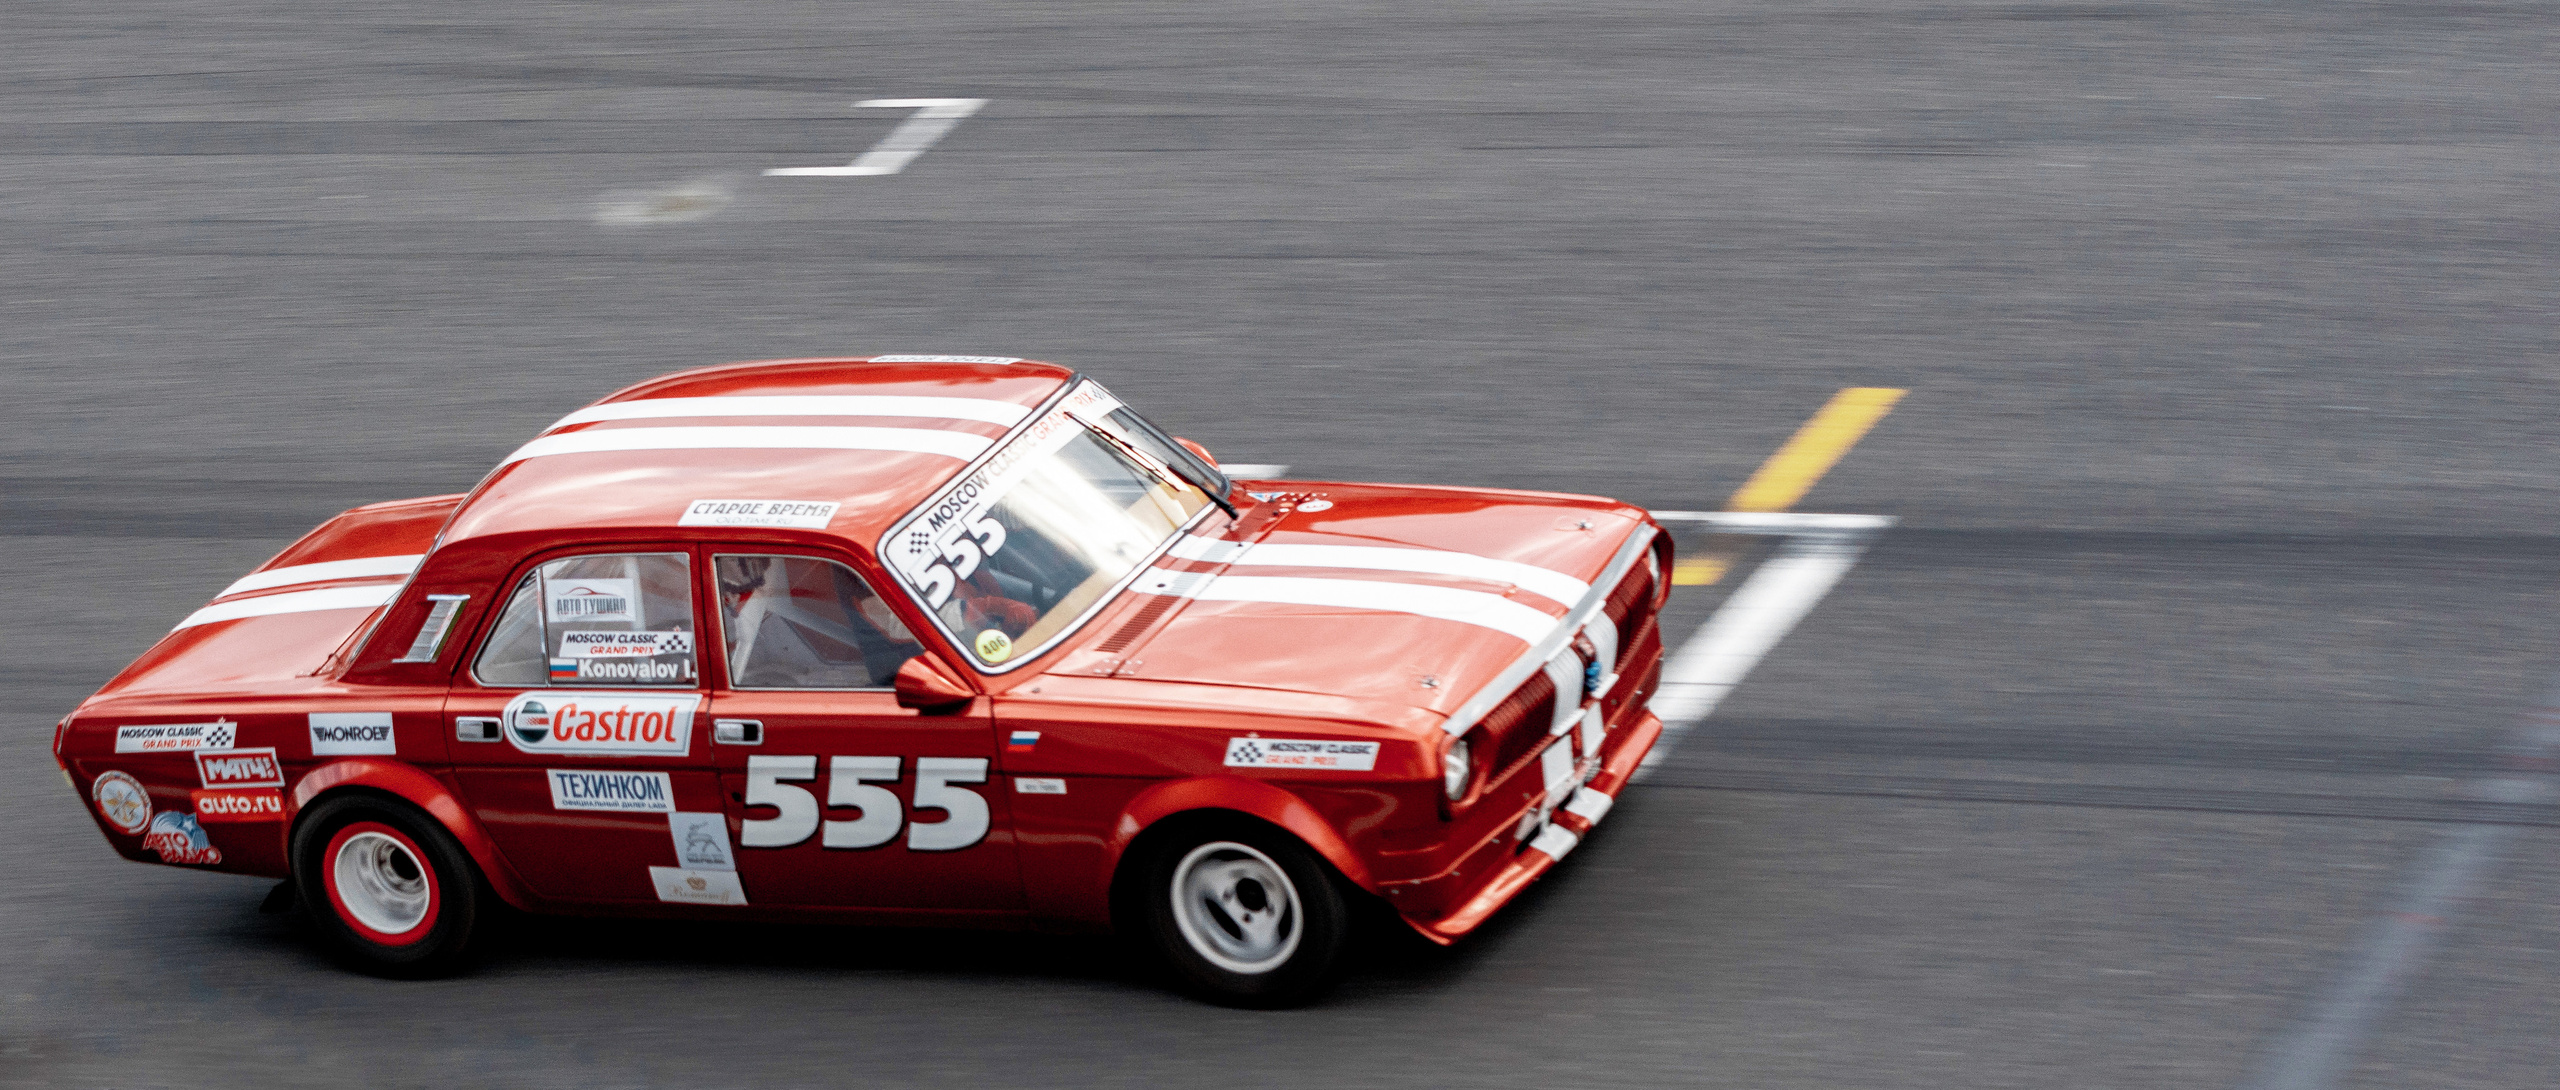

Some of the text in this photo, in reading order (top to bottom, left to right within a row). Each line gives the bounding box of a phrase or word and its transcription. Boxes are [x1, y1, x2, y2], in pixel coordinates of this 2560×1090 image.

[928, 470, 990, 532] MOSCOW
[988, 434, 1036, 476] CLASSIC
[693, 503, 833, 517] СТАРОЕ ВРЕМЯ
[907, 503, 1006, 611] 555
[557, 598, 626, 614] АВТО ТУШИНО
[566, 634, 658, 643] MOSCOW CLASSIC
[982, 635, 1007, 655] 406
[590, 646, 654, 655] GRAND PRIX
[580, 659, 678, 678] Konovalov
[553, 703, 677, 743] Castrol
[121, 727, 204, 739] MOSCOW CLASSIC
[323, 726, 381, 741] MONROE
[143, 739, 201, 749] GRAND PRIX
[556, 773, 665, 800] ТЕХИНКОМ
[200, 794, 281, 814] auto.ru
[742, 755, 990, 850] 555
